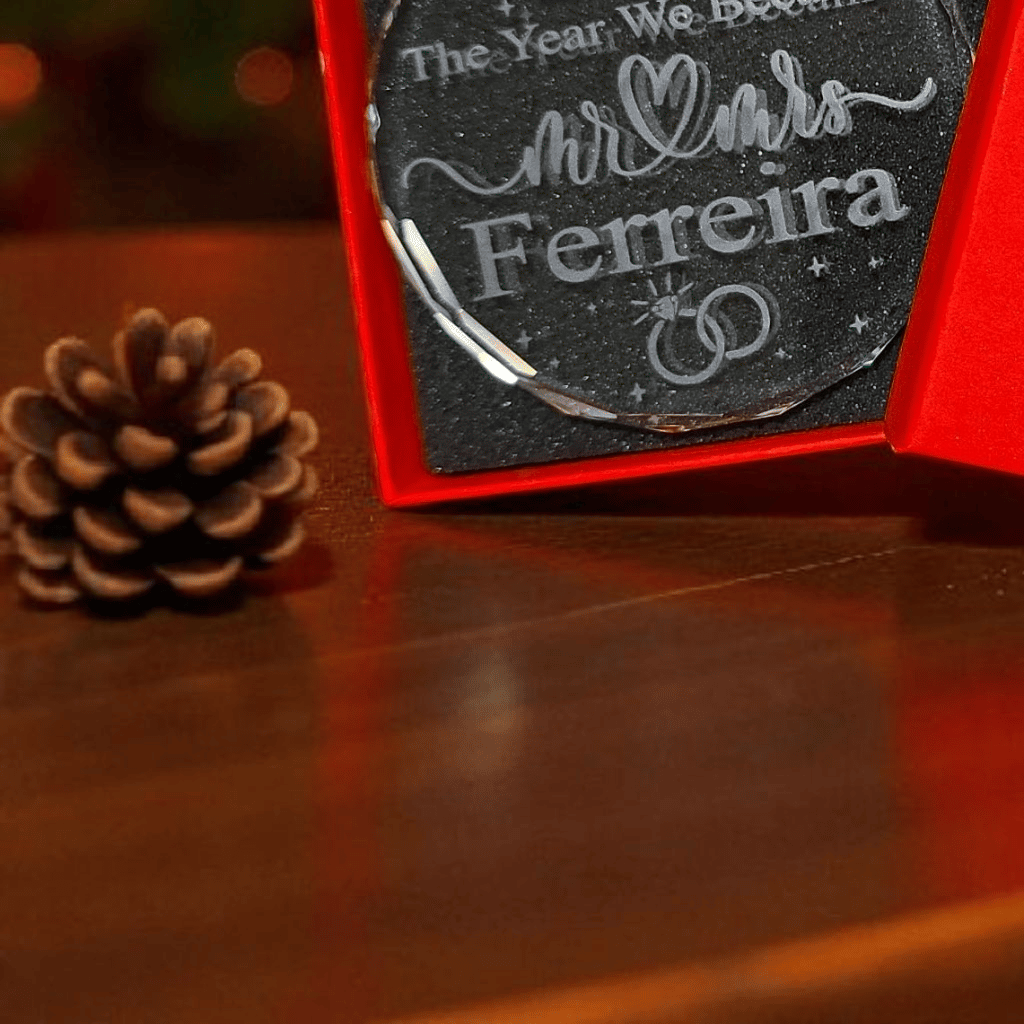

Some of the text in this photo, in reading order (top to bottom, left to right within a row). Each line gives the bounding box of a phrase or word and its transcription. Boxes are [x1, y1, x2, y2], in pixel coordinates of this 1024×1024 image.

[402, 40, 492, 82] The
[500, 19, 606, 60] Year
[616, 0, 694, 38] We
[459, 161, 911, 303] Ferreira
